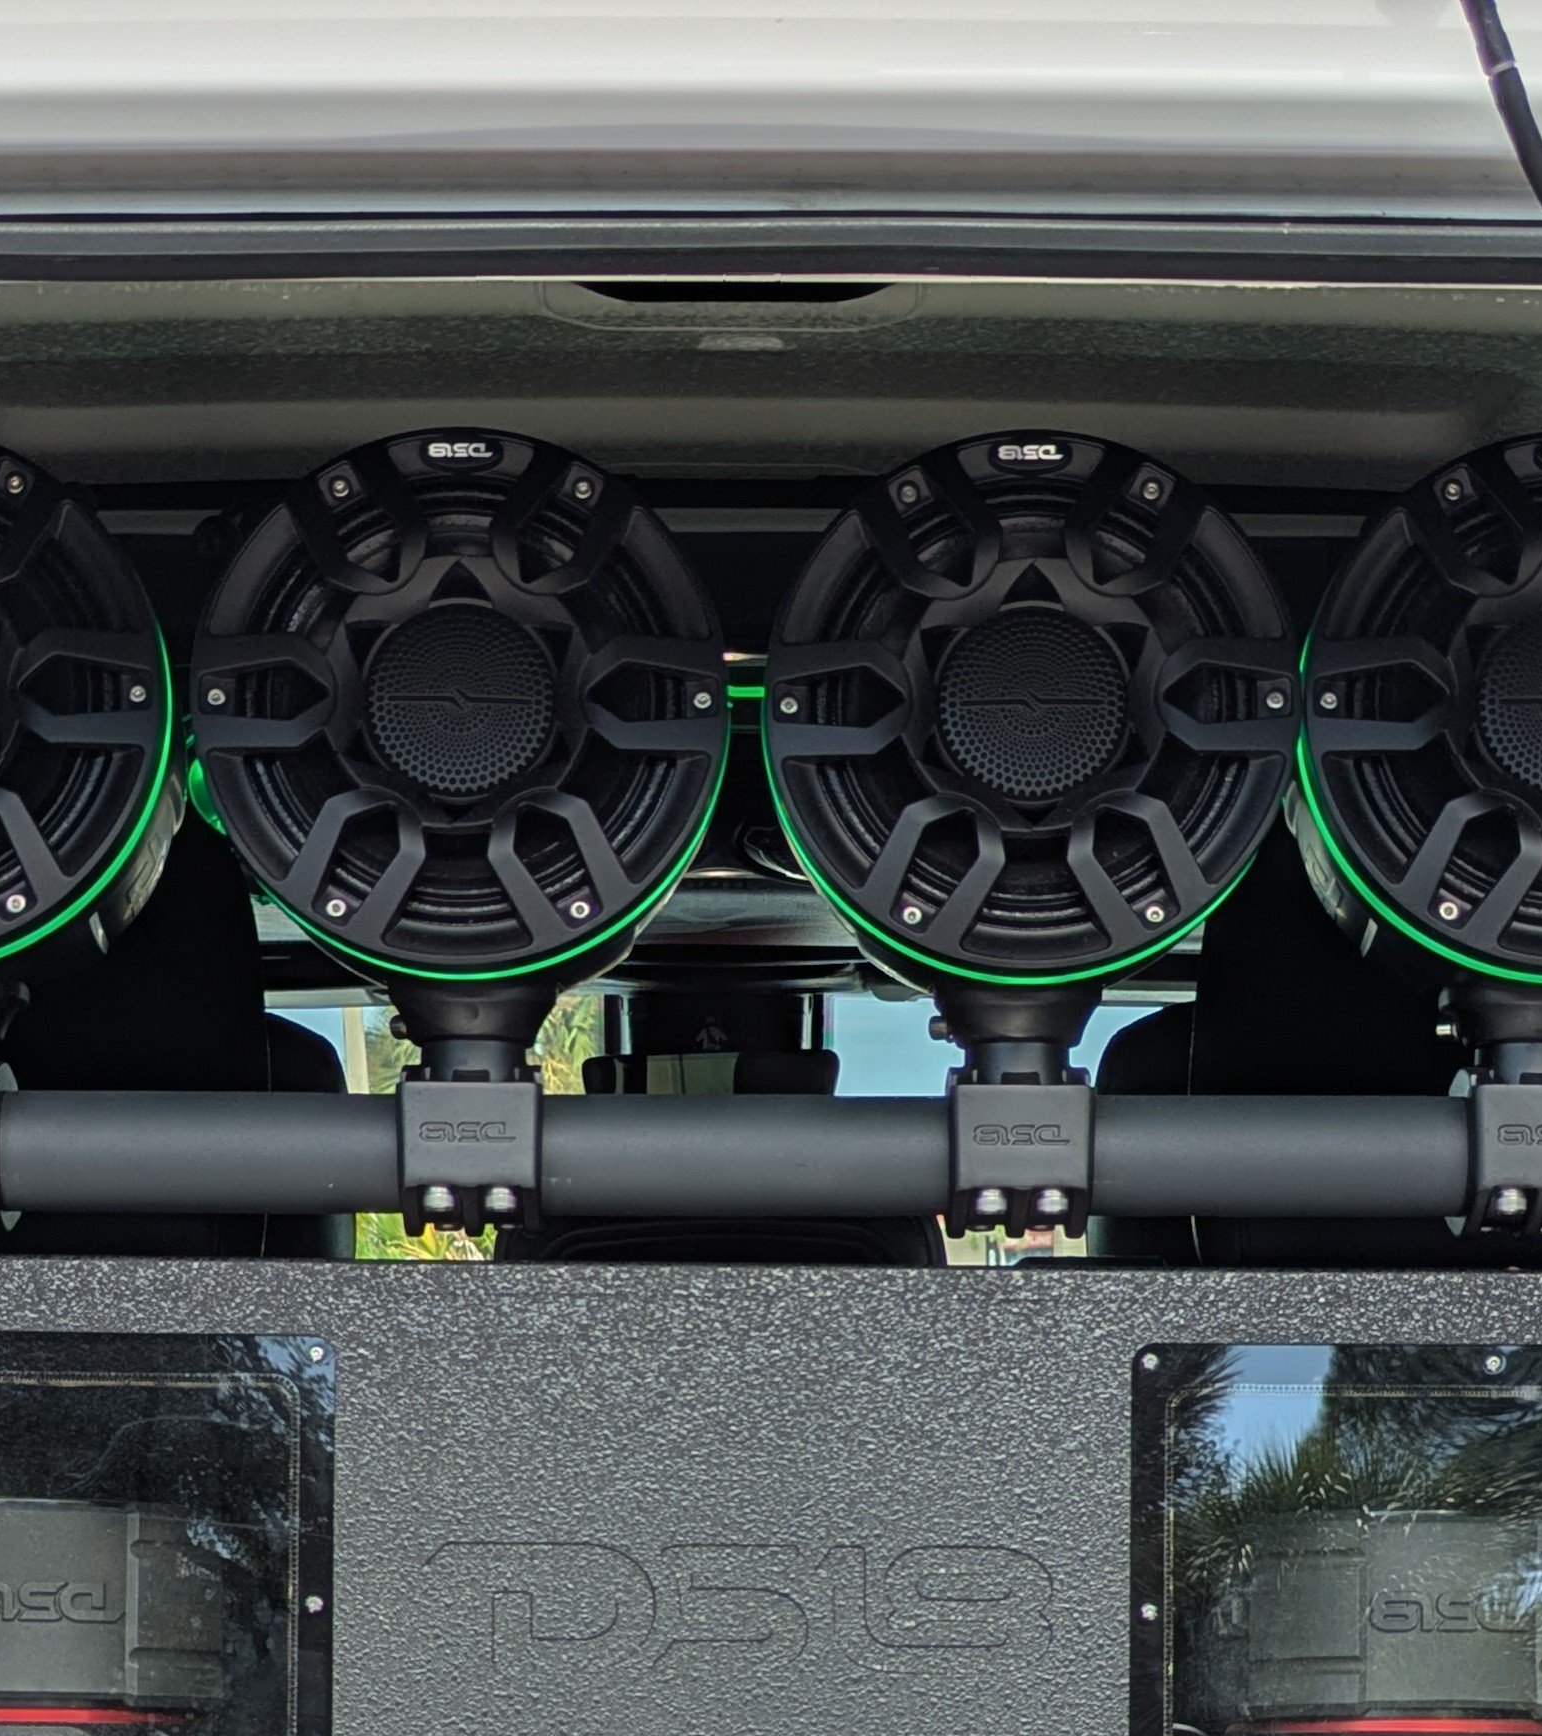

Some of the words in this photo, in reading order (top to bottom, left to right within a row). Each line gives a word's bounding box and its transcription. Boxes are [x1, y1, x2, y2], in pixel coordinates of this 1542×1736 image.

[428, 442, 494, 458] DS18
[997, 444, 1064, 461] DS18
[419, 1121, 516, 1143] DS18
[972, 1124, 1071, 1146] DS18
[420, 1541, 1054, 1676] DS18
